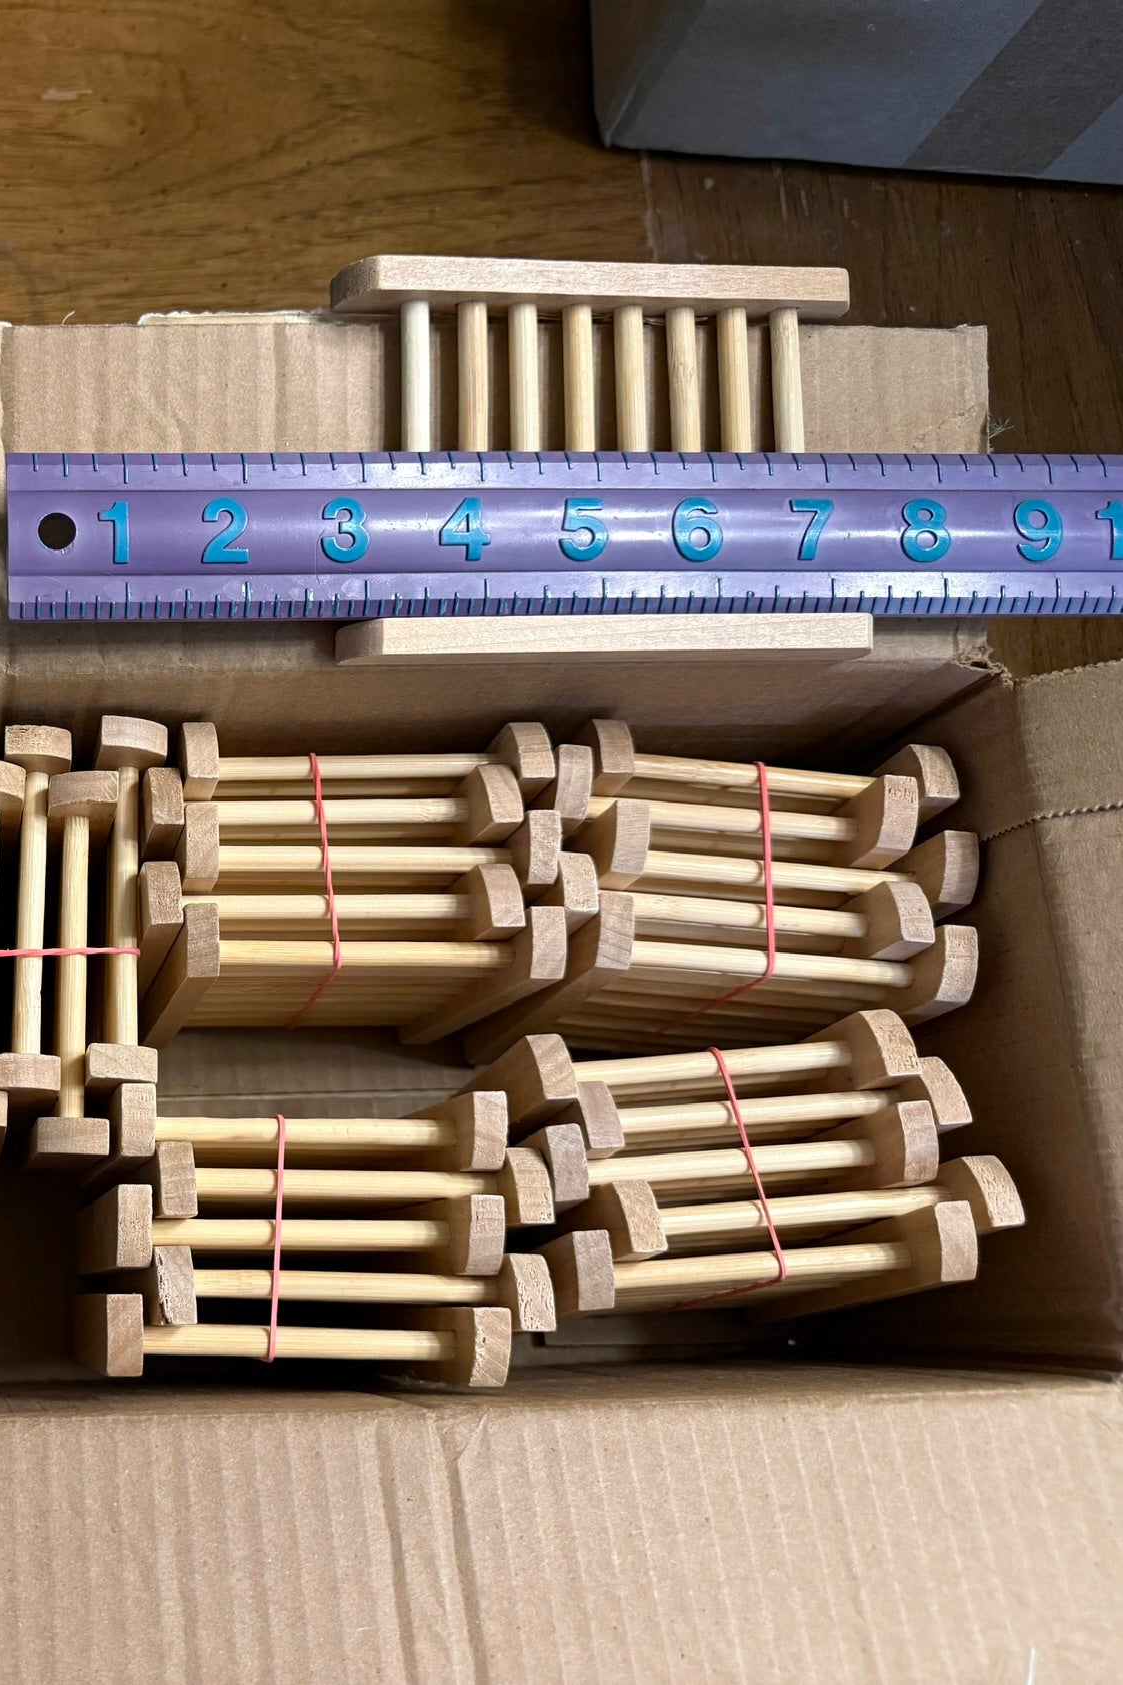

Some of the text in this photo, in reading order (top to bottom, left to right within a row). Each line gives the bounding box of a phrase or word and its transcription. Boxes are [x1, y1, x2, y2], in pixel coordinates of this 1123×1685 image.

[97, 500, 130, 565] 1
[201, 497, 251, 564] 2
[320, 497, 370, 563] 3
[438, 496, 490, 562] 4
[558, 496, 608, 562] 5
[671, 496, 724, 563] 6
[788, 498, 835, 562] 7
[899, 497, 954, 564] 8
[1012, 497, 1064, 564] 9
